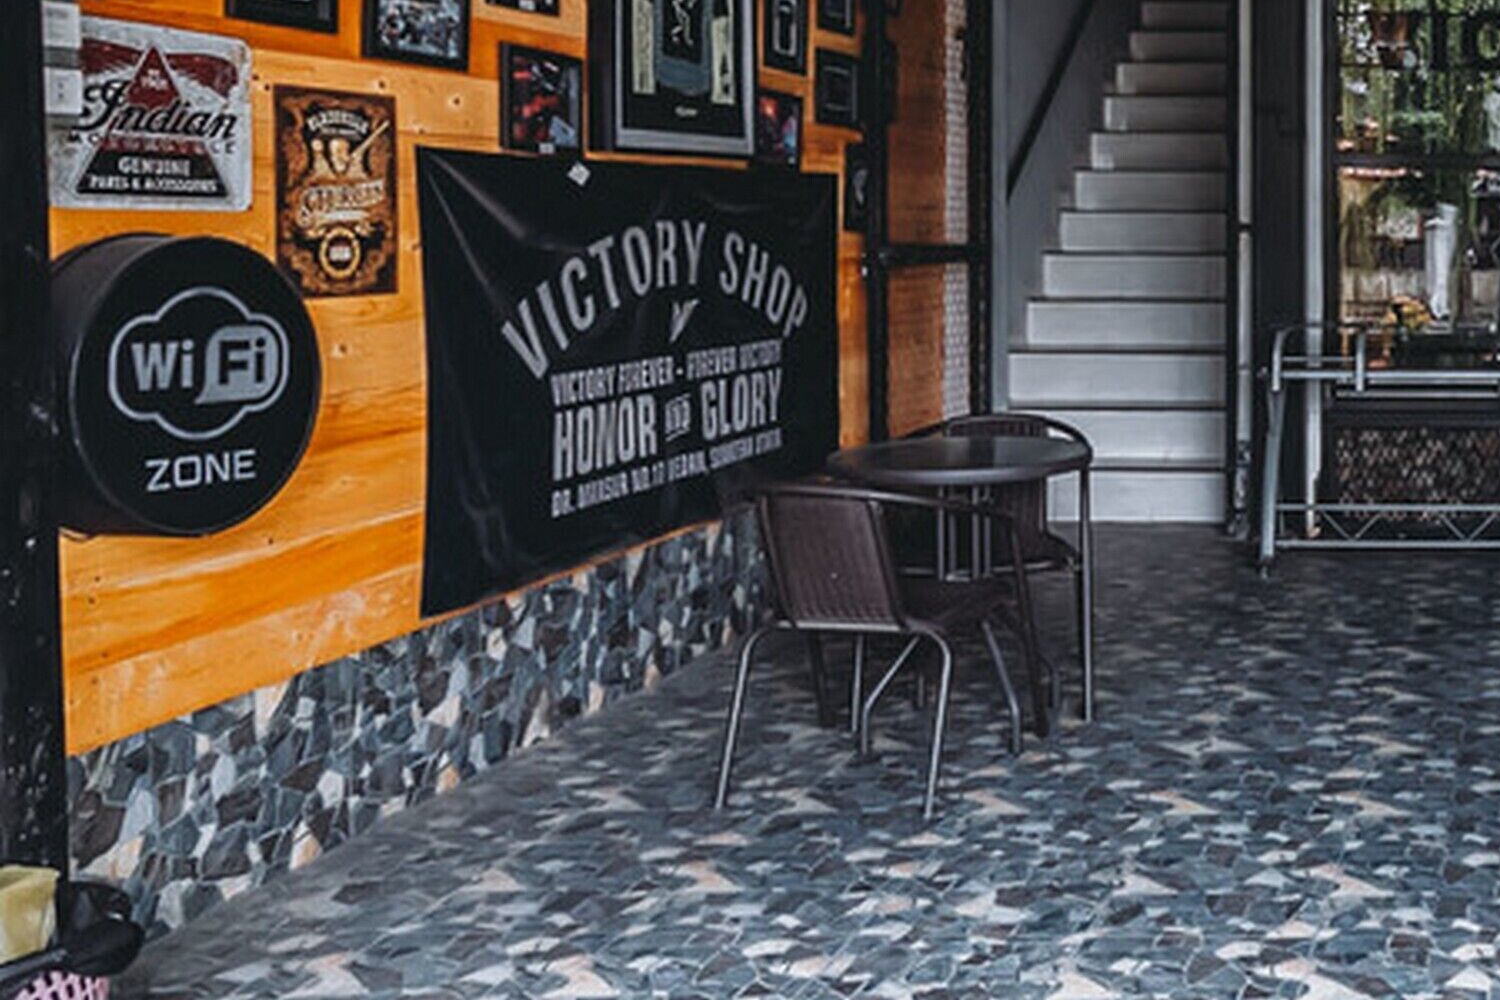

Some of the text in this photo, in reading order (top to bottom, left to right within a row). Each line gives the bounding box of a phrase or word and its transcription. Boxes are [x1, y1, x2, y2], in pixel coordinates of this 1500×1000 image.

[502, 219, 807, 380] VICTORY SHOP
[551, 364, 615, 407] VICTORY
[553, 394, 657, 481] HONOR
[701, 368, 782, 441] GLORY
[145, 449, 257, 493] ZONE
